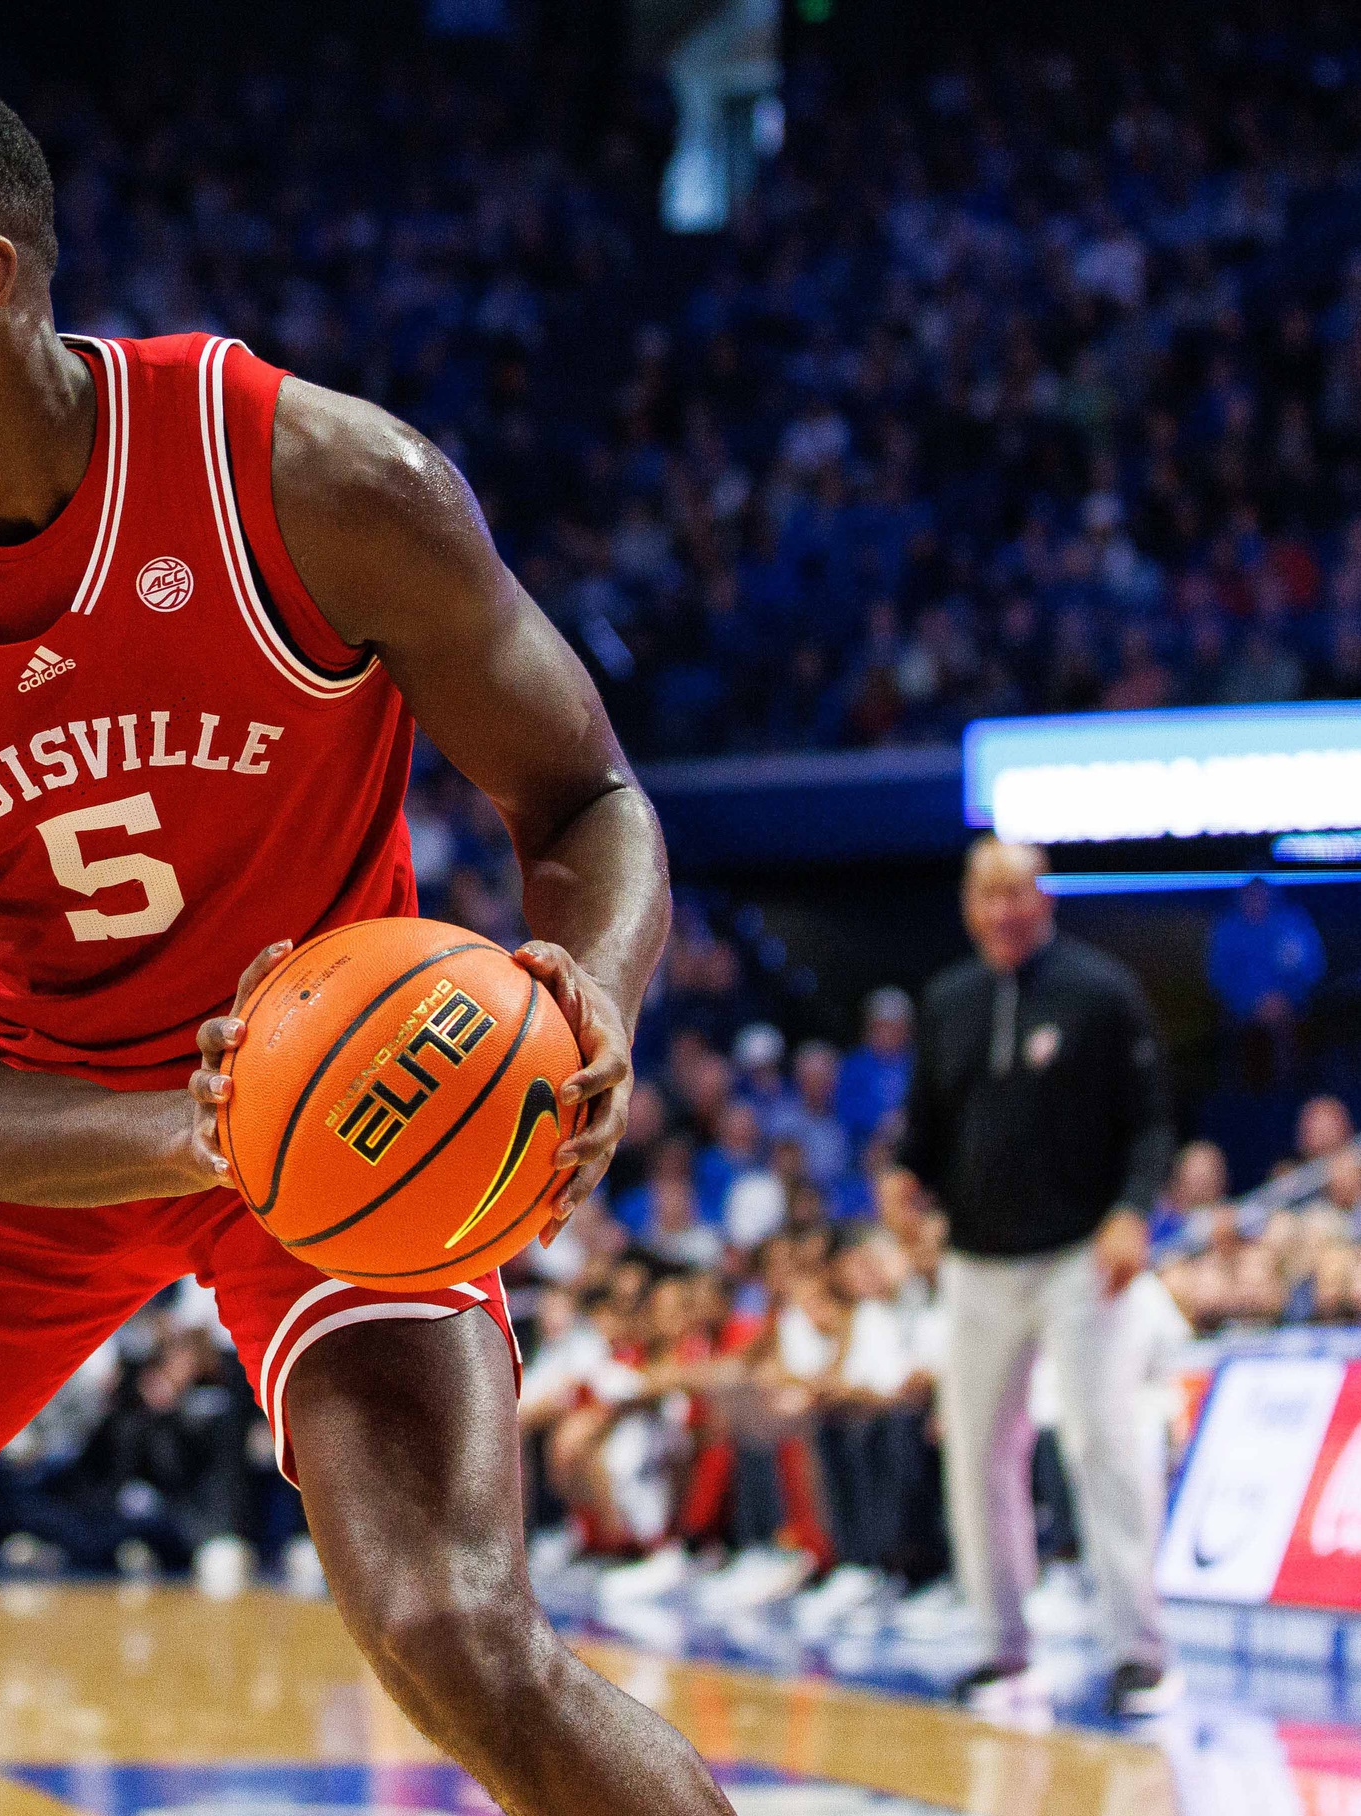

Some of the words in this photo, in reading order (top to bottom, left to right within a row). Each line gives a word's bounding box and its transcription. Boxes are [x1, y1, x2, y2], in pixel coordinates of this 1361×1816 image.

[146, 568, 186, 592] ACC
[17, 658, 77, 693] adidas
[36, 791, 185, 942] 5
[334, 987, 498, 1166] ELITE
